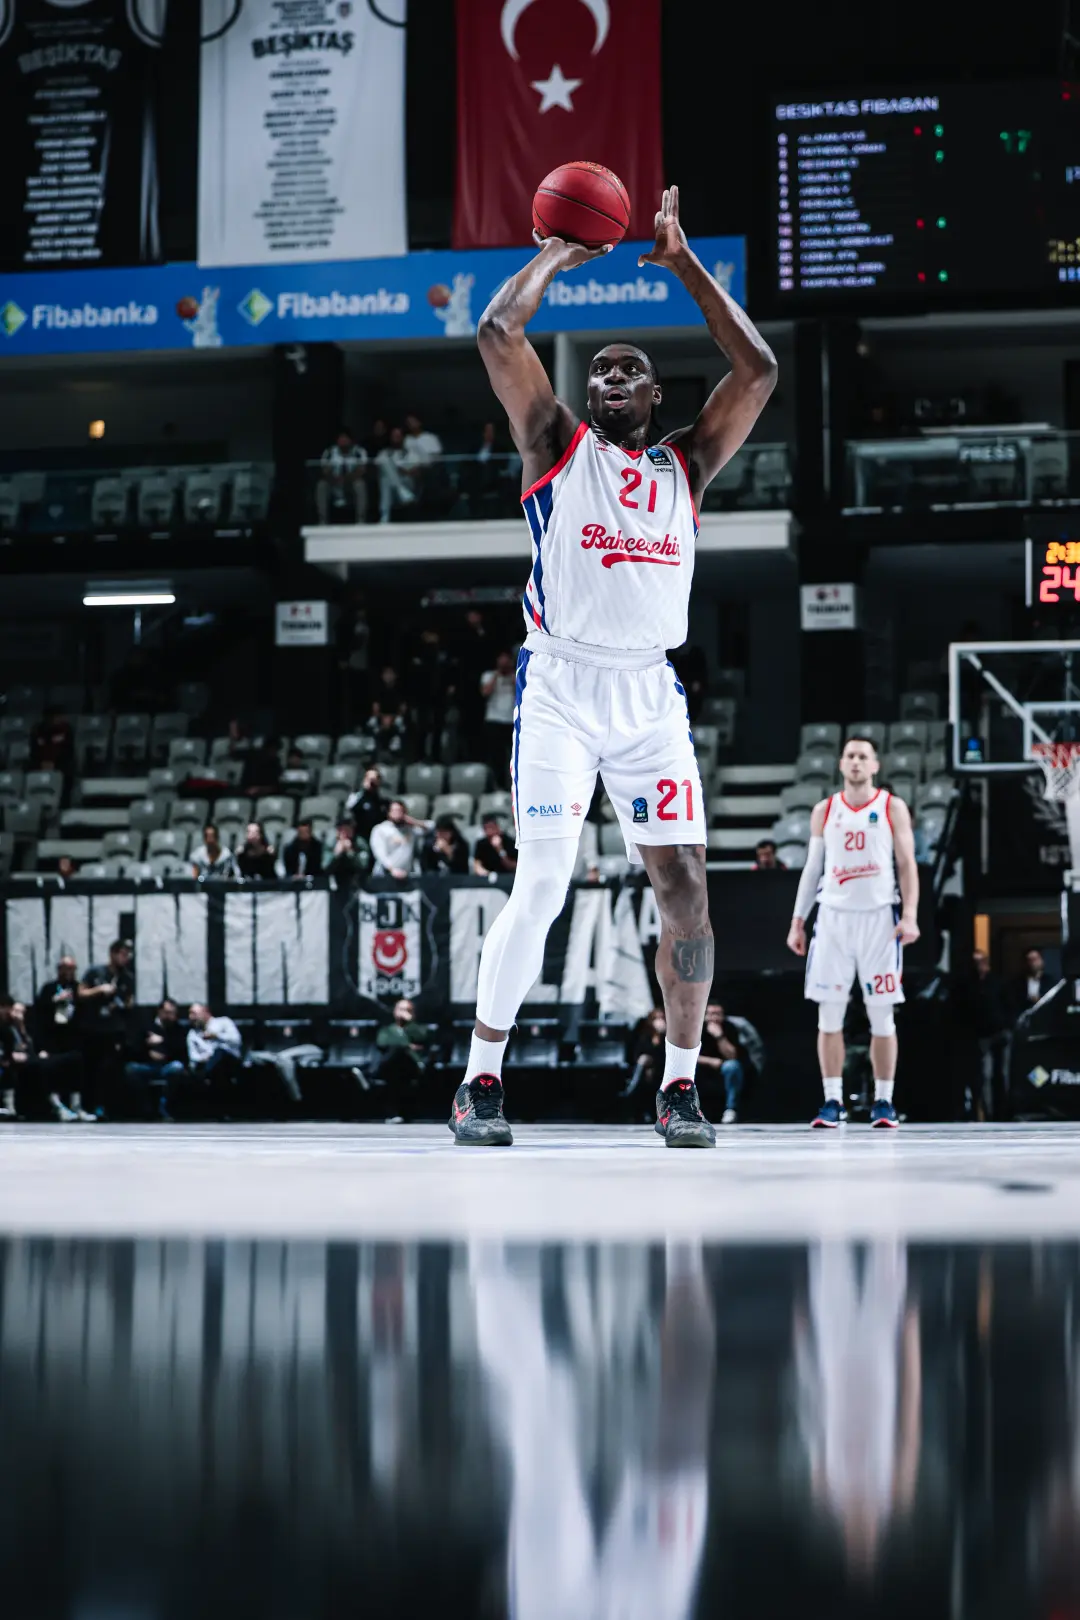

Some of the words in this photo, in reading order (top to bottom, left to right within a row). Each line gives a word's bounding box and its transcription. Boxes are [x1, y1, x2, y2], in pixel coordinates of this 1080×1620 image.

[278, 289, 409, 319] Fibabanka
[544, 277, 668, 306] ibabanka
[32, 301, 158, 329] Fibabanka
[618, 467, 658, 513] 21
[1039, 566, 1080, 602] 24
[539, 804, 562, 814] BAU
[656, 779, 693, 821] 21
[844, 831, 865, 851] 20
[873, 973, 896, 994] 20
